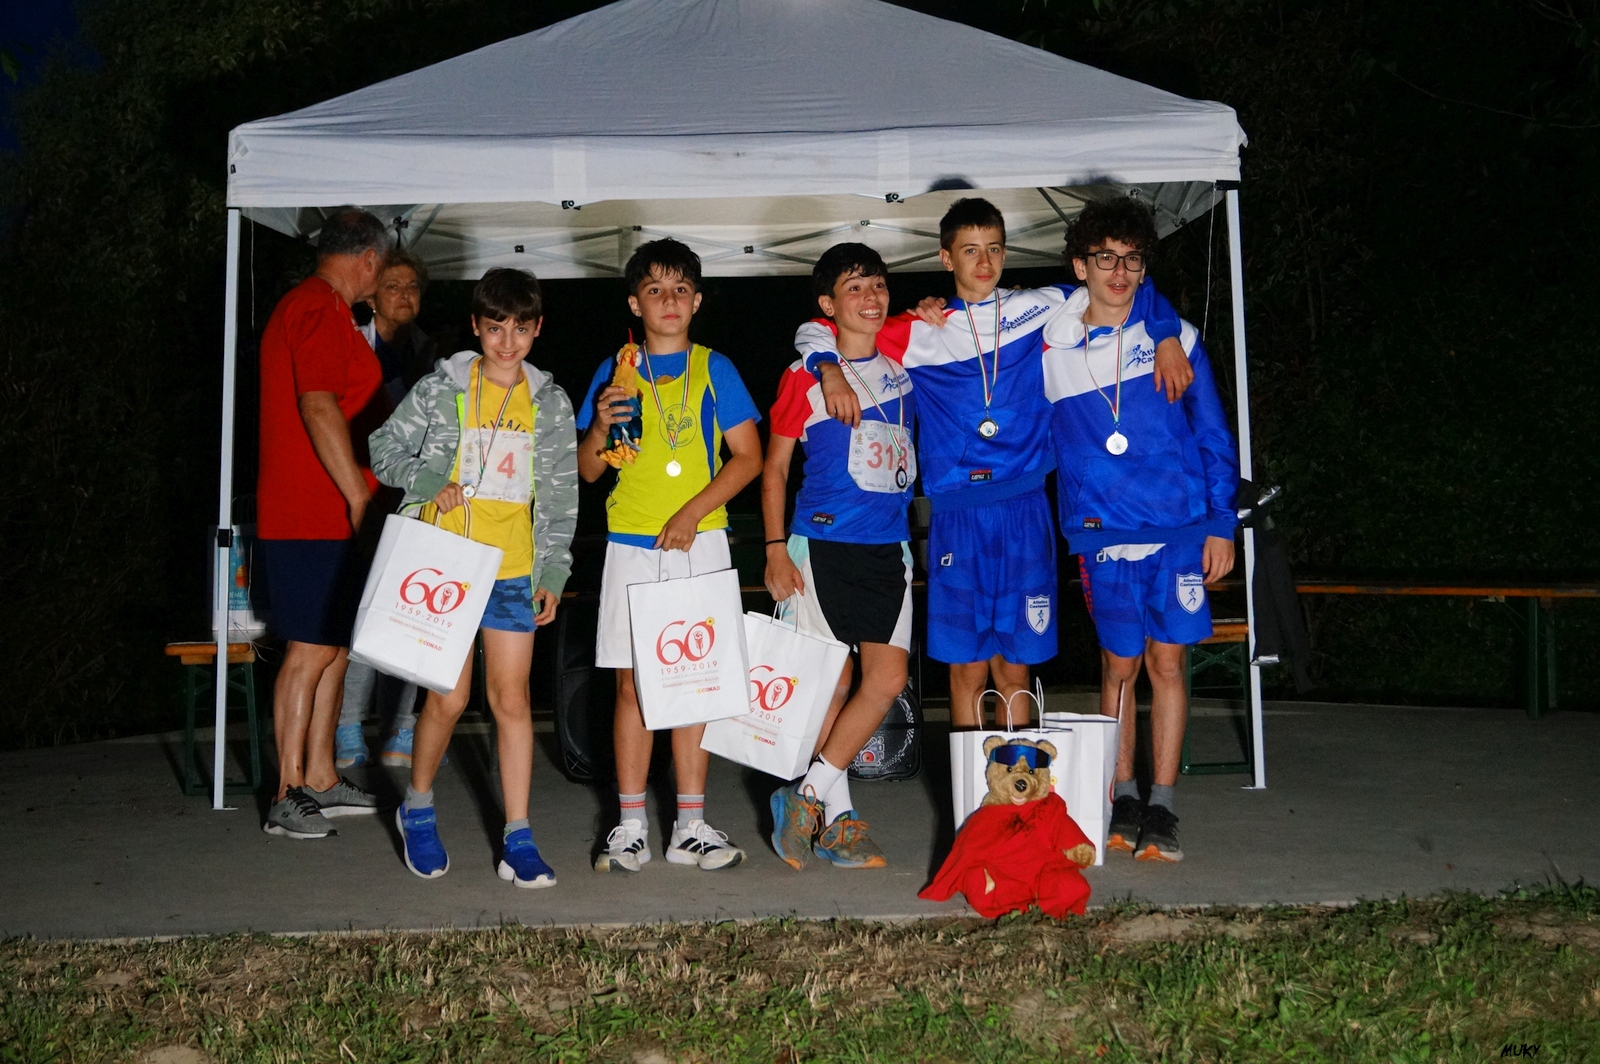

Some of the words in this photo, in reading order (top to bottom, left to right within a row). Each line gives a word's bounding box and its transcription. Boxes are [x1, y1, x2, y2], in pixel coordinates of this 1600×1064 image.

[1010, 305, 1039, 326] Atletica
[1011, 305, 1050, 329] Castenaso
[497, 451, 516, 479] 4
[867, 441, 908, 471] 318
[400, 567, 466, 615] 60
[394, 601, 453, 629] 1959-2019
[423, 640, 443, 651] CONAD
[656, 620, 715, 665] 60
[660, 660, 718, 675] 1959-2019
